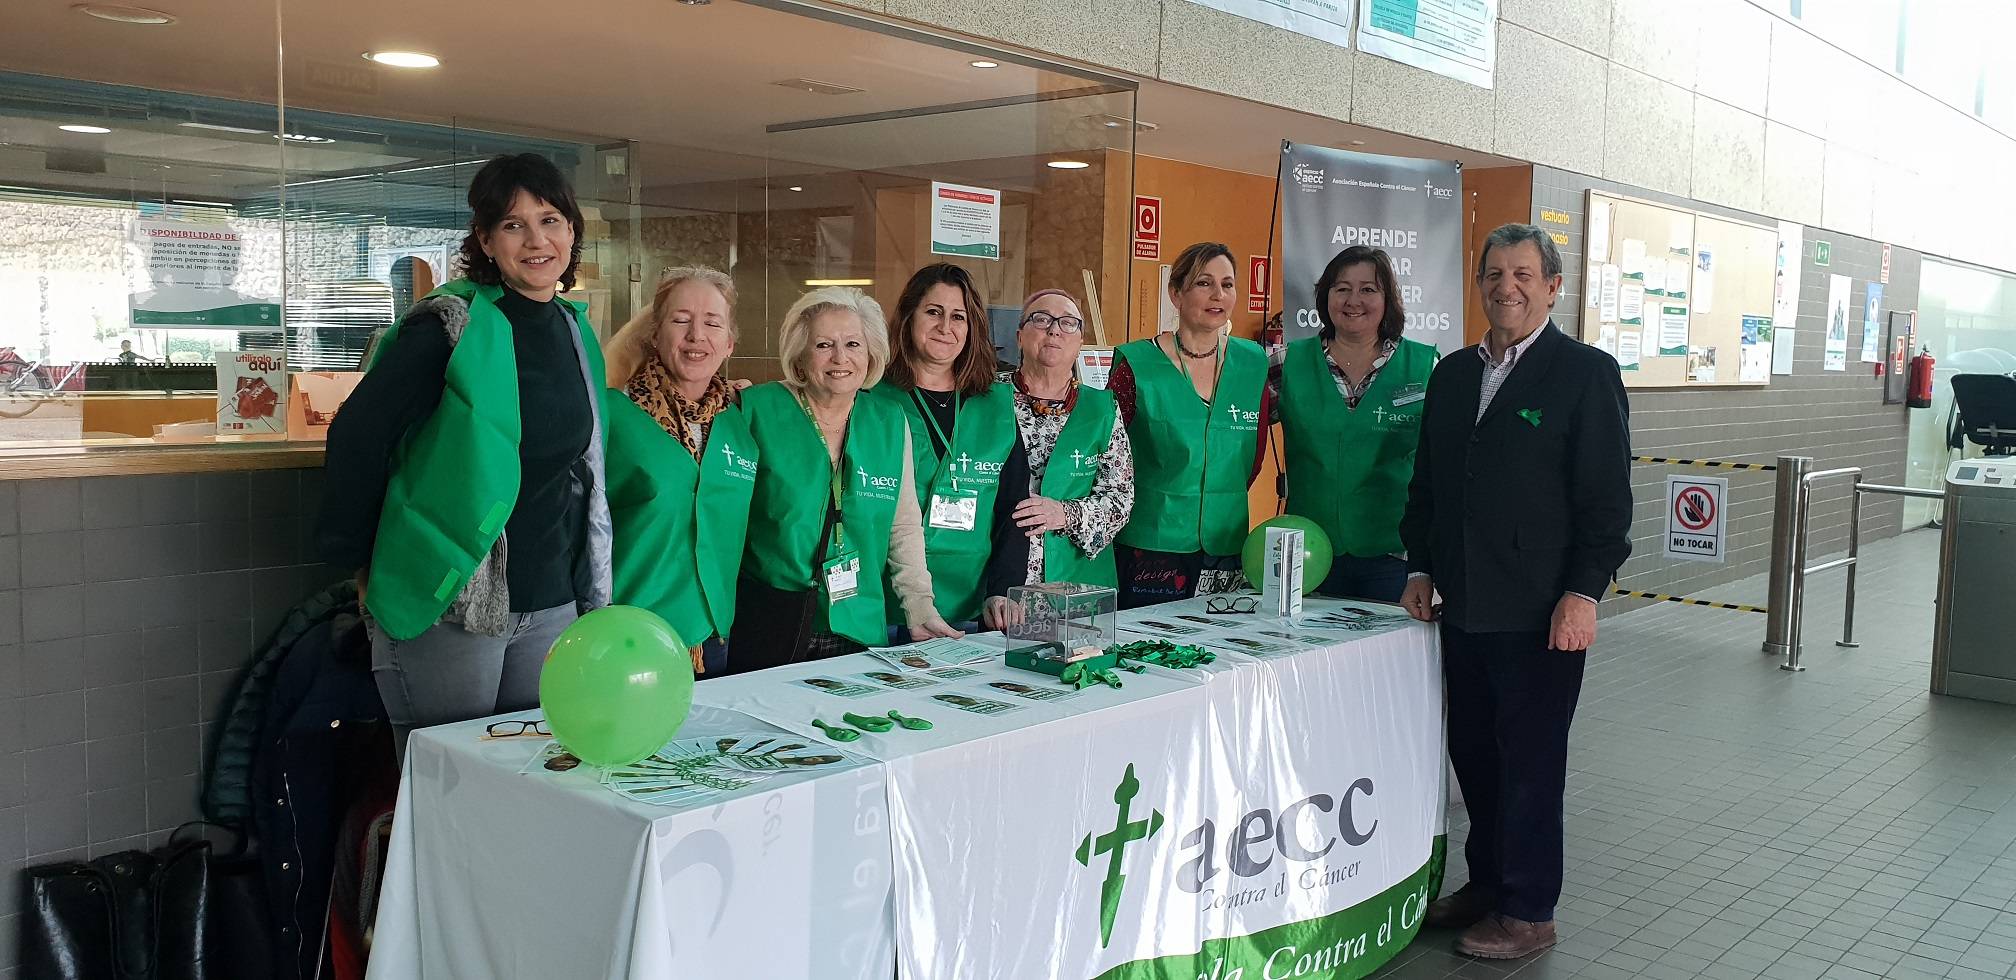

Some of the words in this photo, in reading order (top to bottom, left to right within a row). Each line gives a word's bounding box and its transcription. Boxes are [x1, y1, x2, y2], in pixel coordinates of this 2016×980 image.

[1302, 173, 1324, 184] aecc
[1433, 187, 1453, 197] aecc
[1541, 209, 1569, 224] vestuario
[224, 233, 237, 241] DE
[1331, 225, 1418, 249] APRENDE
[152, 248, 186, 257] isposición
[150, 262, 185, 270] uperiores
[249, 357, 282, 374] aquí
[871, 476, 898, 487] aecc
[1673, 537, 1685, 547] NO
[1687, 539, 1714, 550] TOCAR
[1175, 777, 1379, 894] aecc
[1202, 886, 1267, 912] Contra
[1273, 872, 1286, 898] el
[1298, 858, 1362, 890] Cáncer
[1262, 932, 1366, 980] Contra
[1376, 905, 1393, 948] el
